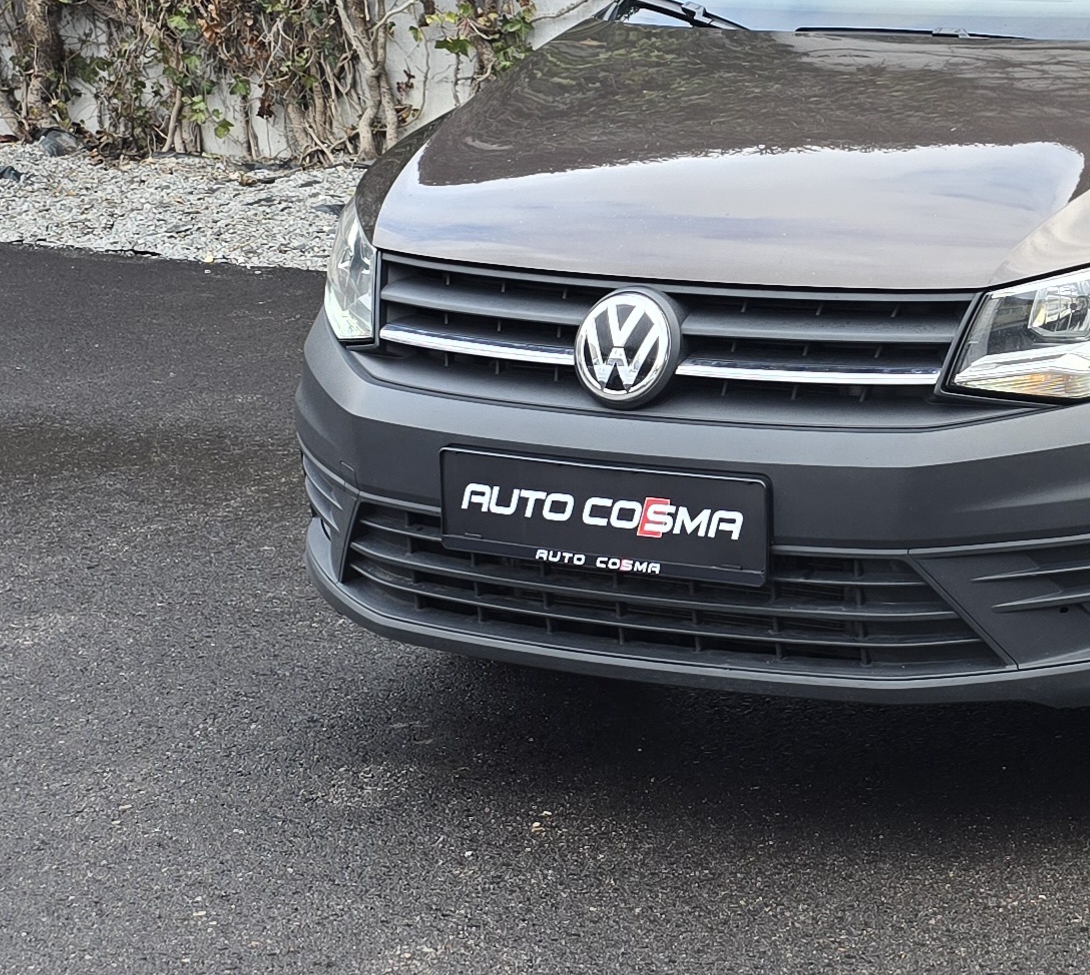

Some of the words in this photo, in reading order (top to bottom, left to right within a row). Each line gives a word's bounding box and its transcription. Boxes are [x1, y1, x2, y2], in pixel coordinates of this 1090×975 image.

[579, 296, 667, 397] VW
[461, 482, 574, 522] AUTO
[582, 496, 744, 541] COSMA
[535, 549, 586, 566] AUTO
[595, 556, 661, 575] COSMA
